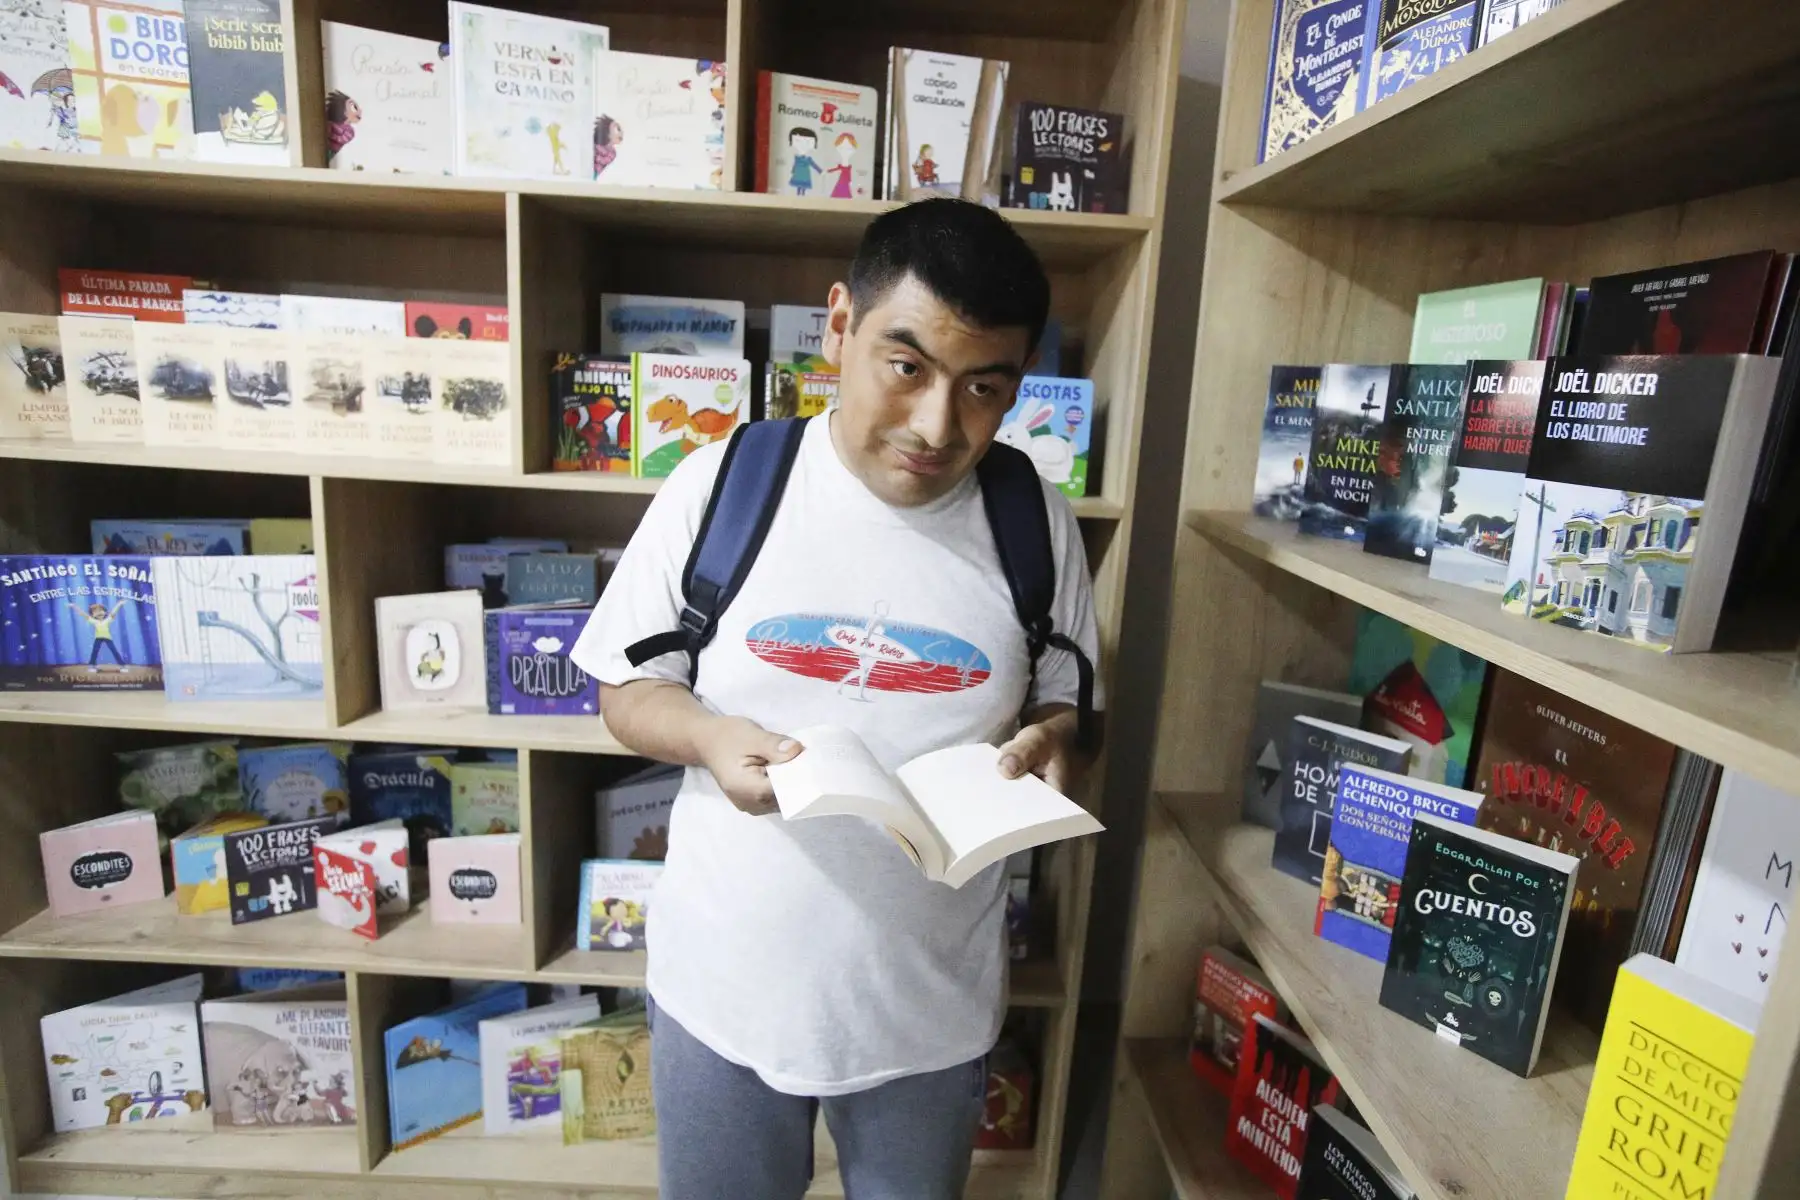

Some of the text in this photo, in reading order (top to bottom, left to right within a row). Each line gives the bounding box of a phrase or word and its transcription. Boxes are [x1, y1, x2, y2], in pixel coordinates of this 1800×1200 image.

[251, 19, 283, 36] scra
[1306, 23, 1322, 47] EL
[1326, 4, 1363, 38] CONDE
[208, 32, 284, 53] bibib blub
[1323, 35, 1338, 51] DE
[1421, 30, 1462, 51] DUMAS
[549, 68, 575, 86] EN
[1308, 59, 1353, 87] ALEJANDRO
[1314, 74, 1342, 94] DUMAS
[494, 79, 576, 104] CAMINO
[777, 101, 820, 120] Romeo
[836, 111, 874, 128] Julieta
[1028, 107, 1109, 139] 100 FRASES
[80, 273, 173, 294] ÚLTIMA PARADA
[67, 292, 84, 305] DE
[85, 293, 102, 306] LA
[104, 294, 142, 309] CALLE
[651, 363, 738, 383] DINOSAURIOS
[1472, 372, 1505, 394] JOËL
[1554, 368, 1659, 396] JOËL DICKER
[1274, 415, 1286, 426] EL
[1550, 400, 1629, 422] EL LIBRO DE
[1406, 426, 1448, 442] ENTRE
[1467, 417, 1520, 435] SOBRE EL
[1545, 420, 1650, 447] LOS BALTIMORE
[1335, 438, 1381, 456] MIKE
[1406, 441, 1453, 457] MUERT
[1463, 435, 1501, 453] HARRY
[1316, 453, 1378, 475] SANTIA
[1330, 475, 1347, 488] EN
[1333, 488, 1371, 504] NOCH
[84, 563, 102, 576] EL
[29, 587, 66, 604] ENTRE
[67, 585, 91, 597] LAS
[835, 629, 857, 645] Only
[879, 642, 905, 659] Riders
[1535, 703, 1608, 746] OLIVER JEFFERS
[1333, 744, 1379, 766] TUDOR
[1555, 748, 1569, 767] EL
[1293, 780, 1318, 804] DE
[1344, 774, 1411, 803] ALFREDO
[1340, 803, 1365, 818] DOS
[1342, 788, 1419, 819] ECHENIQU
[1412, 795, 1461, 819] BRYCE
[1338, 814, 1411, 844] CONVERSAN
[236, 825, 322, 857] 100 FRASES
[74, 857, 131, 876] ESCONDITES
[1435, 842, 1541, 890] EDGAR ALLAN POE
[1414, 888, 1537, 939] CUENTOS
[1622, 1056, 1656, 1088] DE
[1255, 1077, 1309, 1132] ALGUIEN
[1261, 1107, 1292, 1146] ESTÁ
[1614, 1093, 1716, 1174] GRIE
[1322, 1149, 1342, 1172] DEL
[1327, 1141, 1378, 1200] LOS JUEGOS
